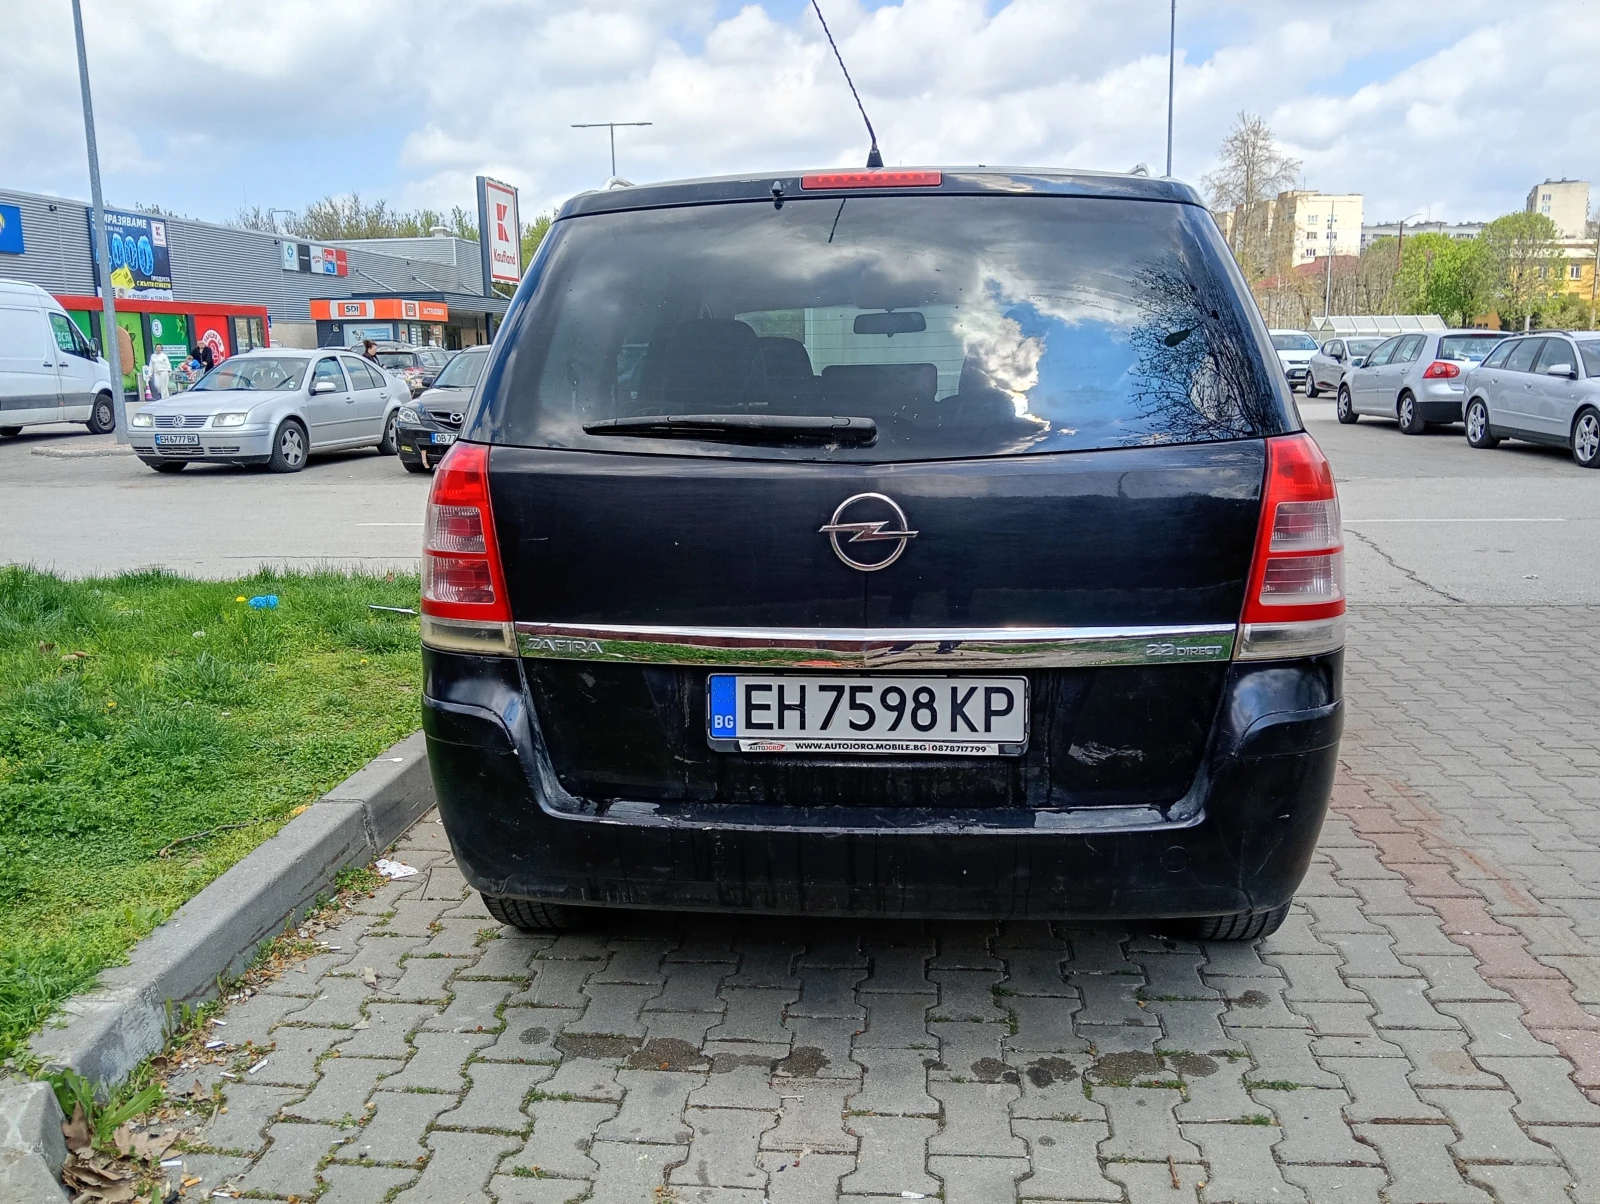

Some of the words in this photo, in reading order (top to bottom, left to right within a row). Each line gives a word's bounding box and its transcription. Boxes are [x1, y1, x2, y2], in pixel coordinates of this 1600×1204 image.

[493, 248, 516, 265] Kaufland
[345, 305, 359, 313] SDI
[526, 637, 604, 654] ZAFIRA
[1176, 645, 1223, 656] DIRECT
[714, 715, 734, 729] BG
[795, 742, 927, 751] WWW.AUTOJORO.MOBILE.BG
